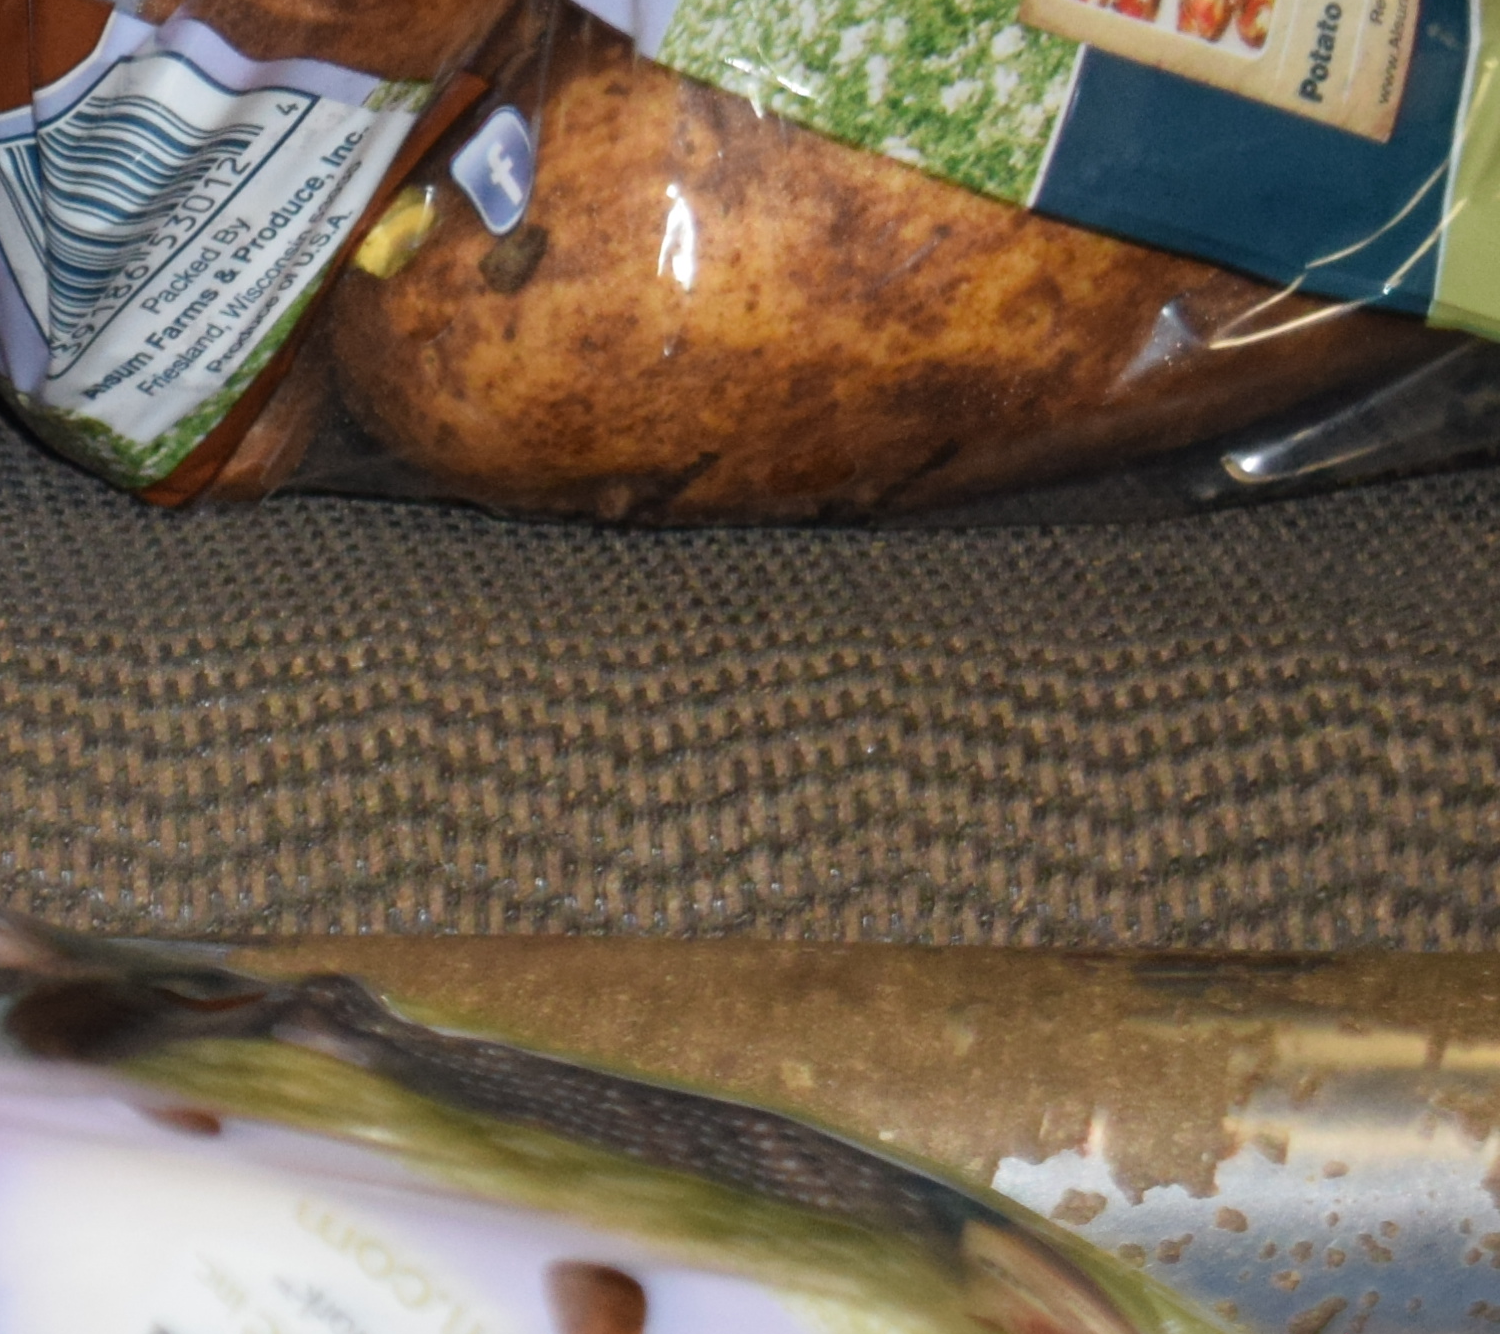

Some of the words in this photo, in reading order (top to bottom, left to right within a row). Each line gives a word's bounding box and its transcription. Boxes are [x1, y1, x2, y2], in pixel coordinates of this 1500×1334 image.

[1299, 1, 1342, 103] Potato
[150, 157, 252, 250] 53012
[275, 100, 300, 118] 4
[140, 247, 222, 317] Packed
[212, 216, 253, 248] By
[145, 288, 220, 352] Farms
[212, 264, 241, 285] &
[231, 173, 336, 265] Produce,
[136, 320, 232, 398] Friesland,
